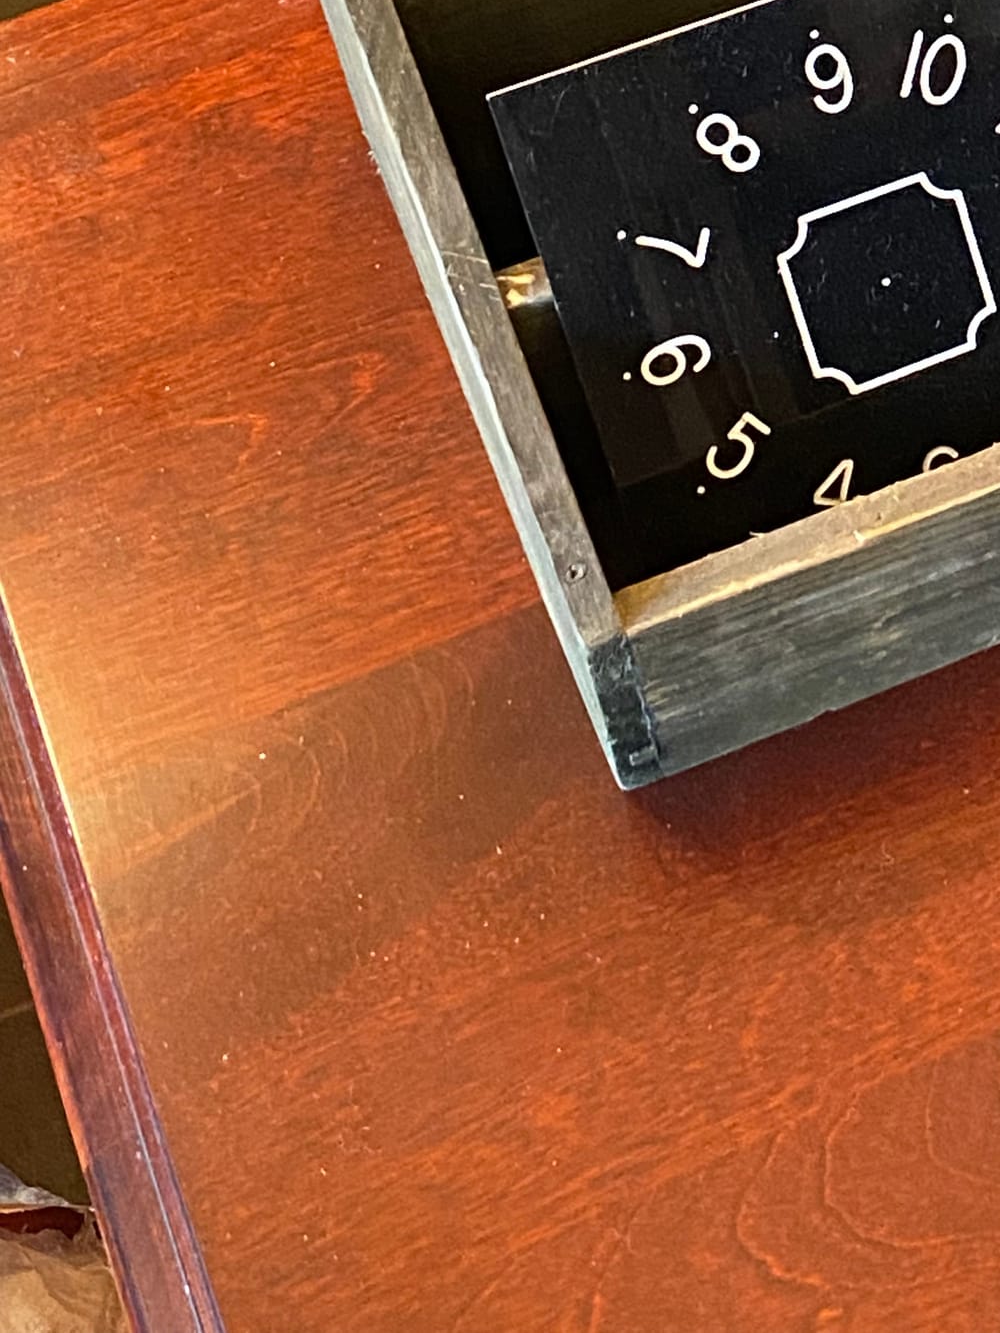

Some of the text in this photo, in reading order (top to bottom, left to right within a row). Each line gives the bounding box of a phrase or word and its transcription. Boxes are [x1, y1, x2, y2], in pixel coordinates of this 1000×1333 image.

[803, 42, 855, 115] 9
[899, 28, 968, 107] 10
[695, 111, 762, 174] 8
[704, 411, 773, 481] 5
